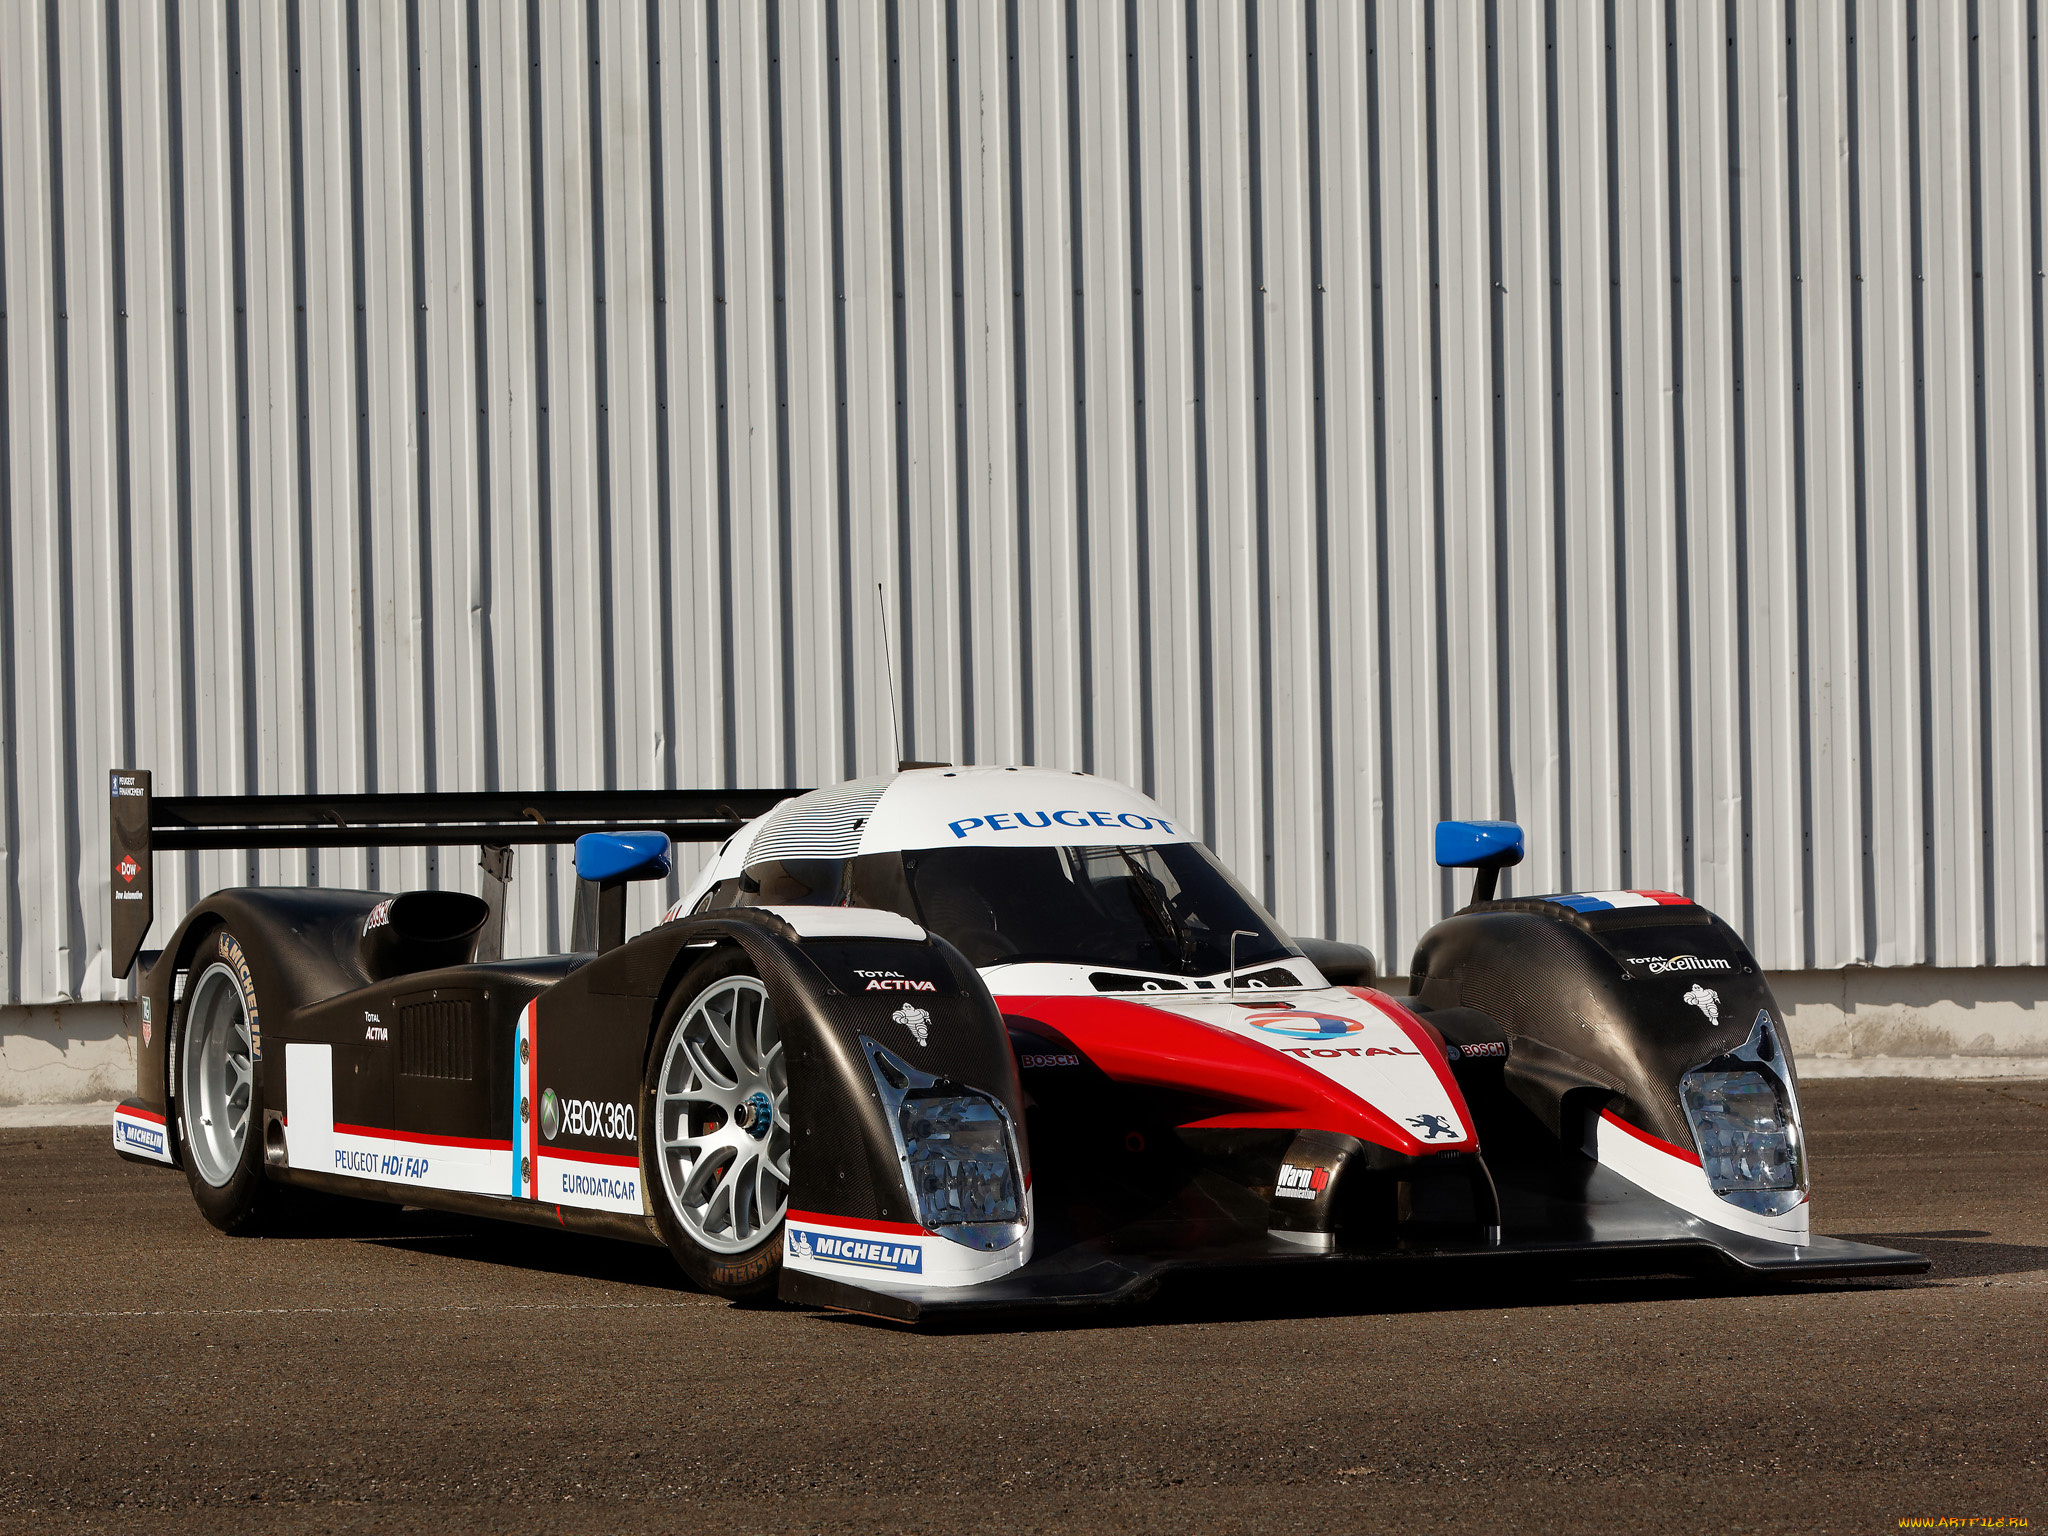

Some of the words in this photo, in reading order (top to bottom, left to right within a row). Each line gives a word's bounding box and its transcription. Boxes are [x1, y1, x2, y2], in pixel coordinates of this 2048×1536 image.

[947, 810, 1175, 839] PEUGEOT
[1626, 956, 1667, 965] TOTAL
[1648, 957, 1731, 973] excellium
[853, 970, 905, 978] TOTAL
[865, 980, 937, 992] ACTIVA
[229, 942, 261, 1057] MICHELIN
[365, 1026, 388, 1041] ACTIVA
[1280, 1047, 1421, 1058] TOTAL
[1460, 1042, 1506, 1057] BOSCH
[1022, 1055, 1079, 1068] BOSCH
[127, 1126, 162, 1148] MICHELIN
[335, 1150, 378, 1172] PEUGEOT
[381, 1155, 403, 1176] HDi
[405, 1158, 429, 1178] FAP
[562, 1173, 635, 1200] EURODATACAR
[816, 1238, 919, 1265] MICHELIN
